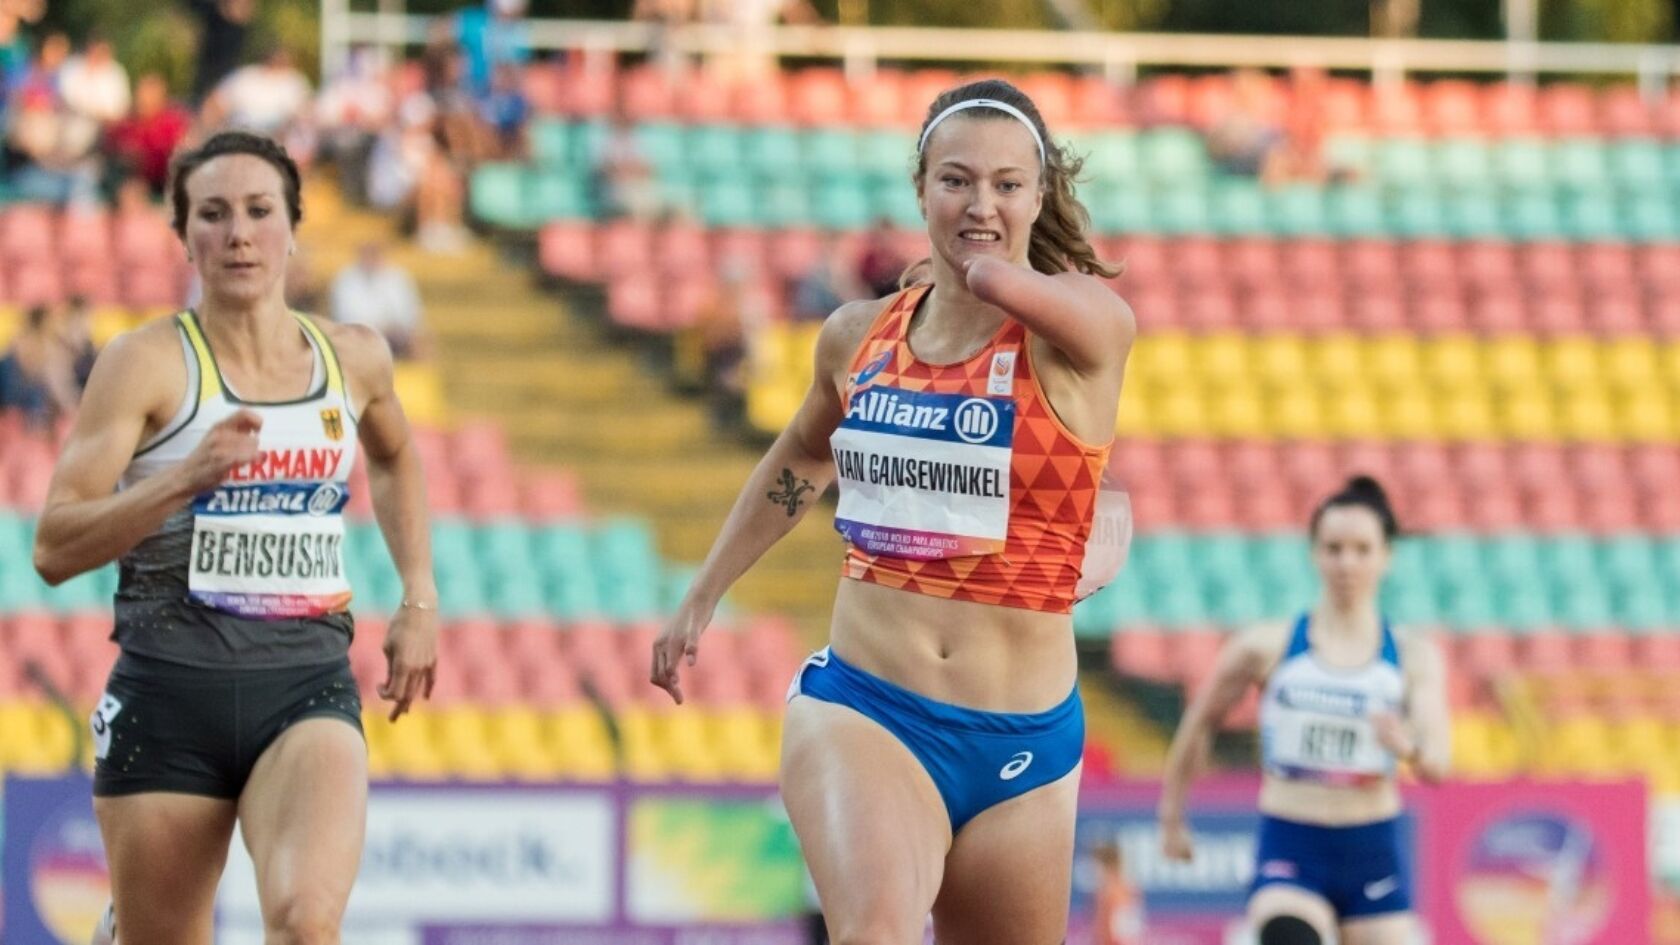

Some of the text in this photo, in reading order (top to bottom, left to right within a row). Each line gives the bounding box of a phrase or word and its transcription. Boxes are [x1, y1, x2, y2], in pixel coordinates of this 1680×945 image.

[847, 391, 948, 430] Allianz
[229, 448, 343, 481] ERMANY
[834, 448, 1004, 498] VAN GANSEWINKEL
[207, 488, 304, 513] Allianz
[195, 530, 341, 578] BENSUSAN
